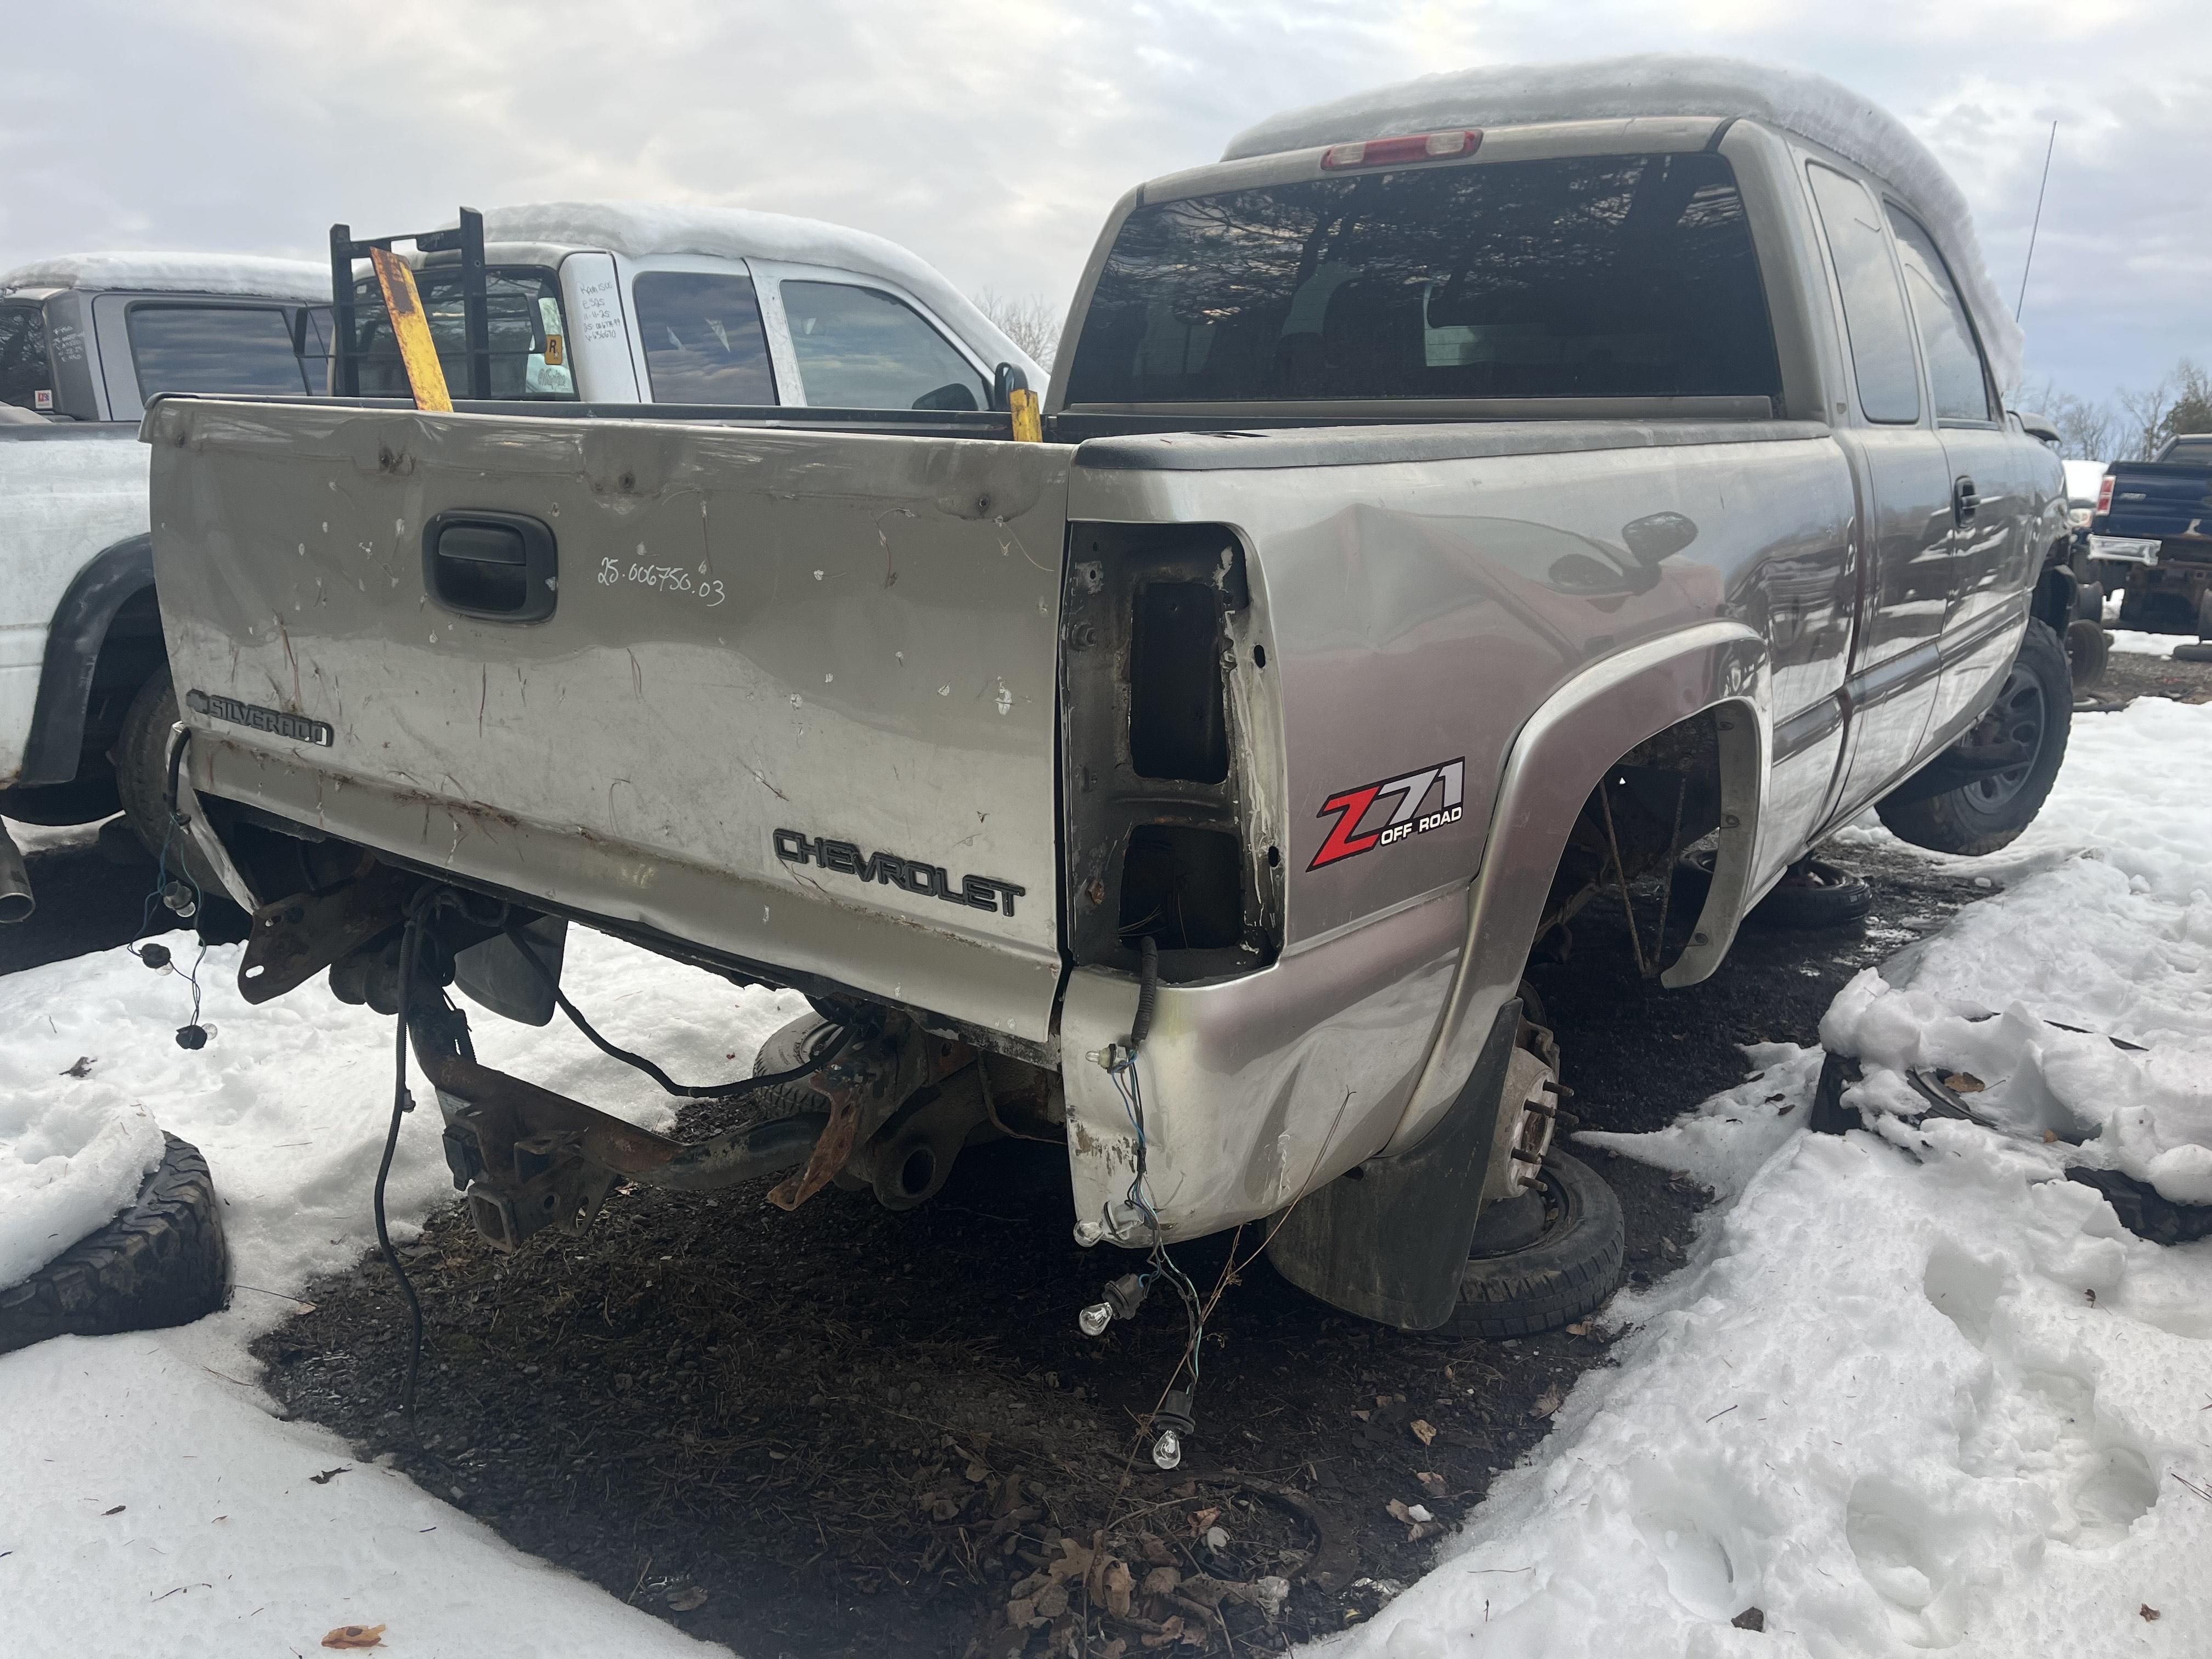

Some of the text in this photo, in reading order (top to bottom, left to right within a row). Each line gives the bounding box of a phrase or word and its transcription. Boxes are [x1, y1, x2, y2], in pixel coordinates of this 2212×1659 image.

[208, 694, 334, 747] SILVERADO
[1306, 757, 1465, 872] Z71
[1381, 806, 1462, 845] OFF ROAD
[772, 828, 1025, 917] CHEVROLET
